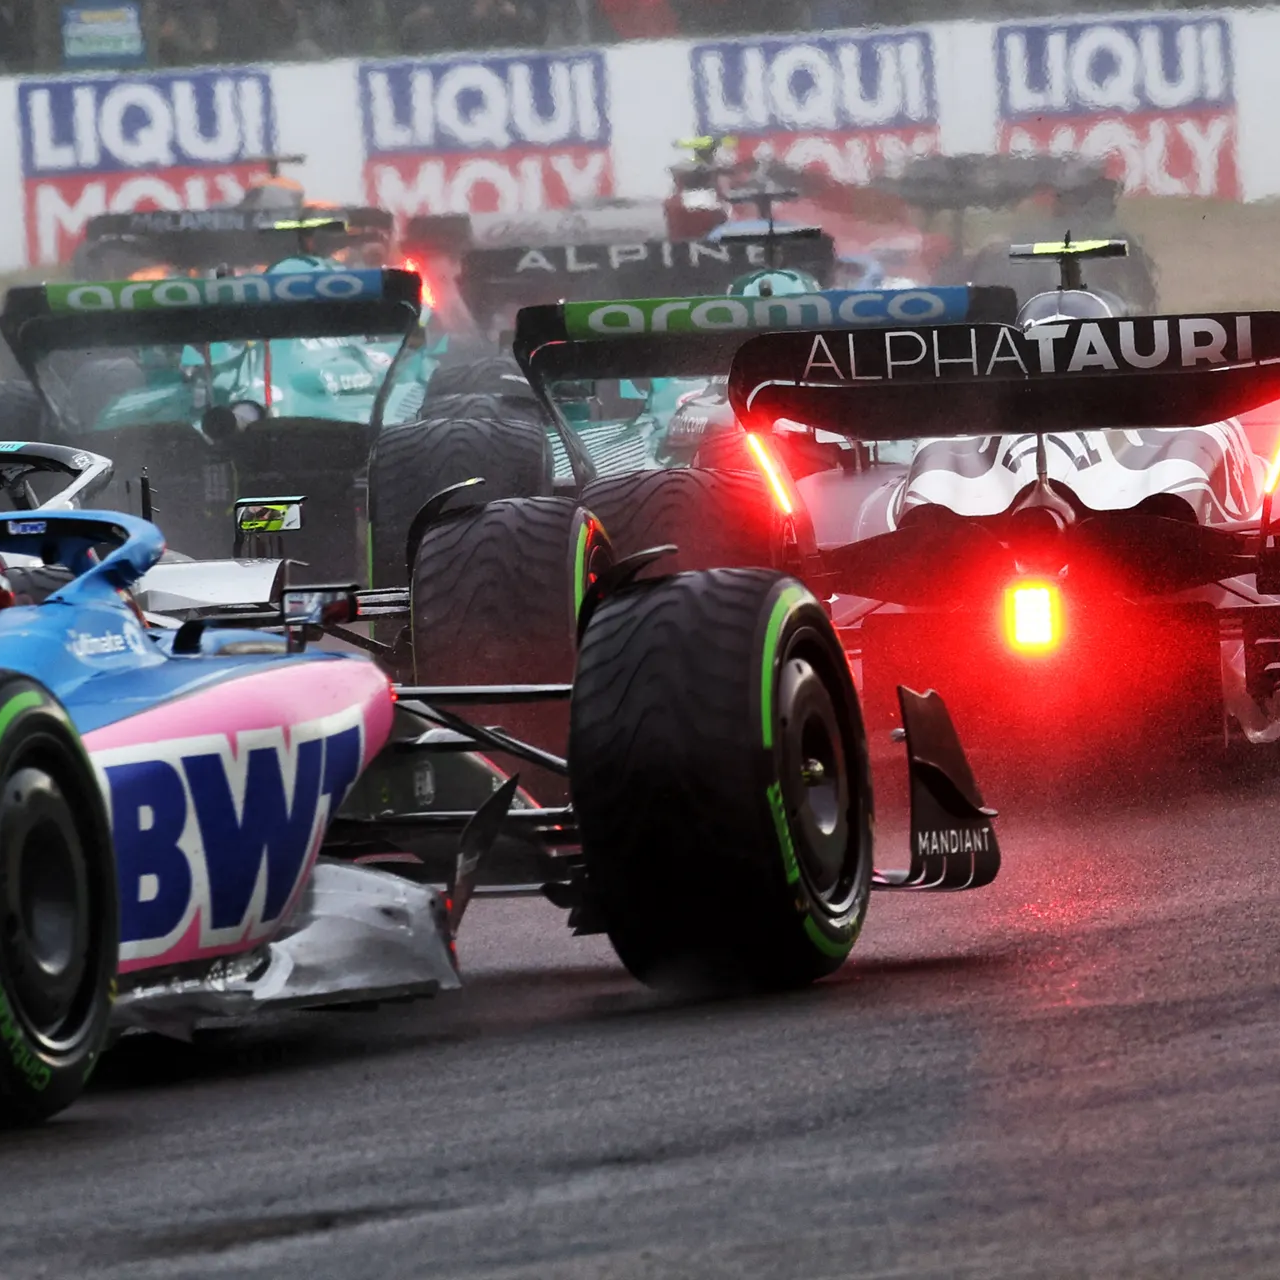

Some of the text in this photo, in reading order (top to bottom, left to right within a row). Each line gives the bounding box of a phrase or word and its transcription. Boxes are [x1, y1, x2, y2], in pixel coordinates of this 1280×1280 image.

[701, 40, 921, 132] LIQUI
[1005, 25, 1229, 111] LIQUI
[28, 80, 266, 169] LIQUI
[368, 63, 601, 152] LIQUI
[516, 240, 768, 273] ALPINE
[67, 274, 364, 311] aramco
[589, 291, 947, 333] aramco
[803, 315, 1253, 380] ALPHATAURI
[918, 827, 989, 856] MANDIANT
